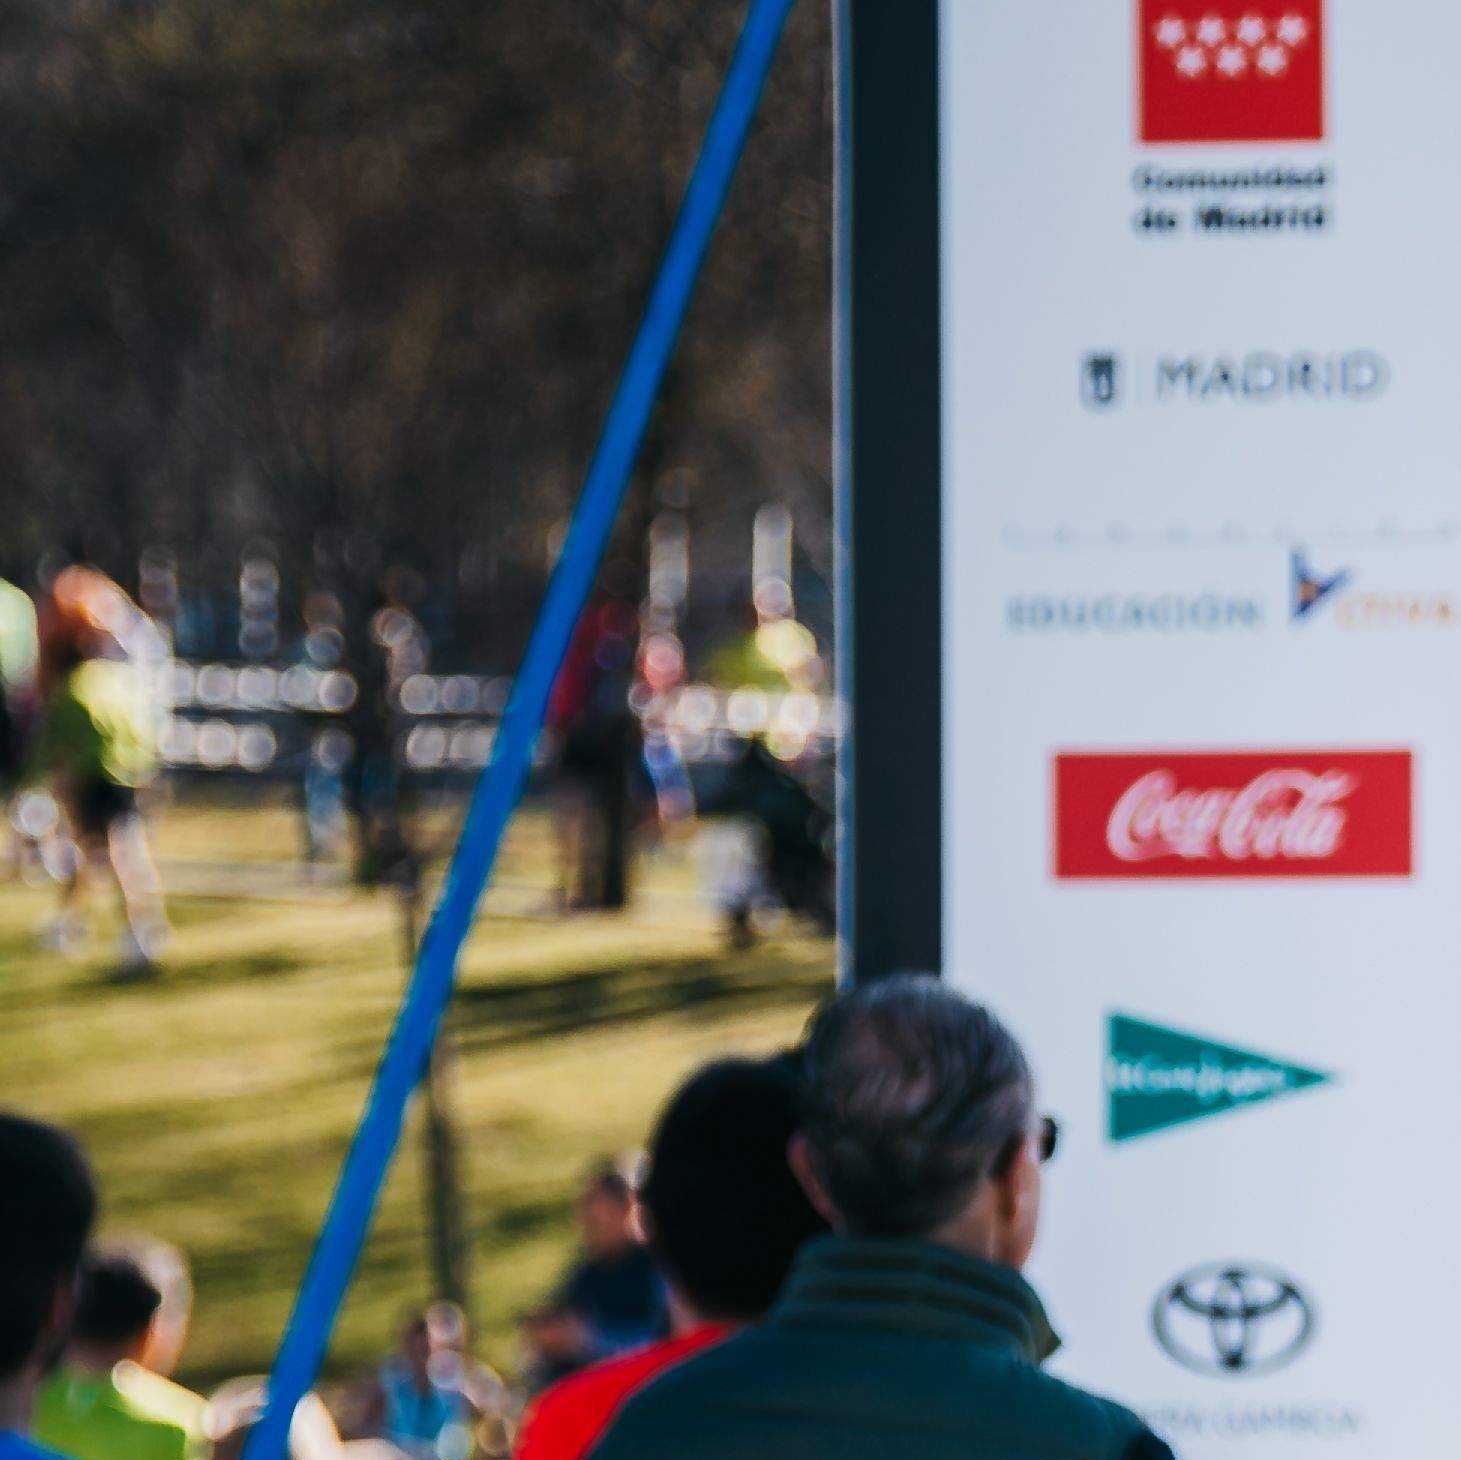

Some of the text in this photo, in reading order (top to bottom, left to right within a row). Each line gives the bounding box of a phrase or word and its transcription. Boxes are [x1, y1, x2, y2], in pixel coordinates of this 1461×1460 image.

[1133, 163, 1330, 192] Comunidad
[1133, 204, 1330, 234] de Madrid
[1156, 351, 1388, 397] MADRID
